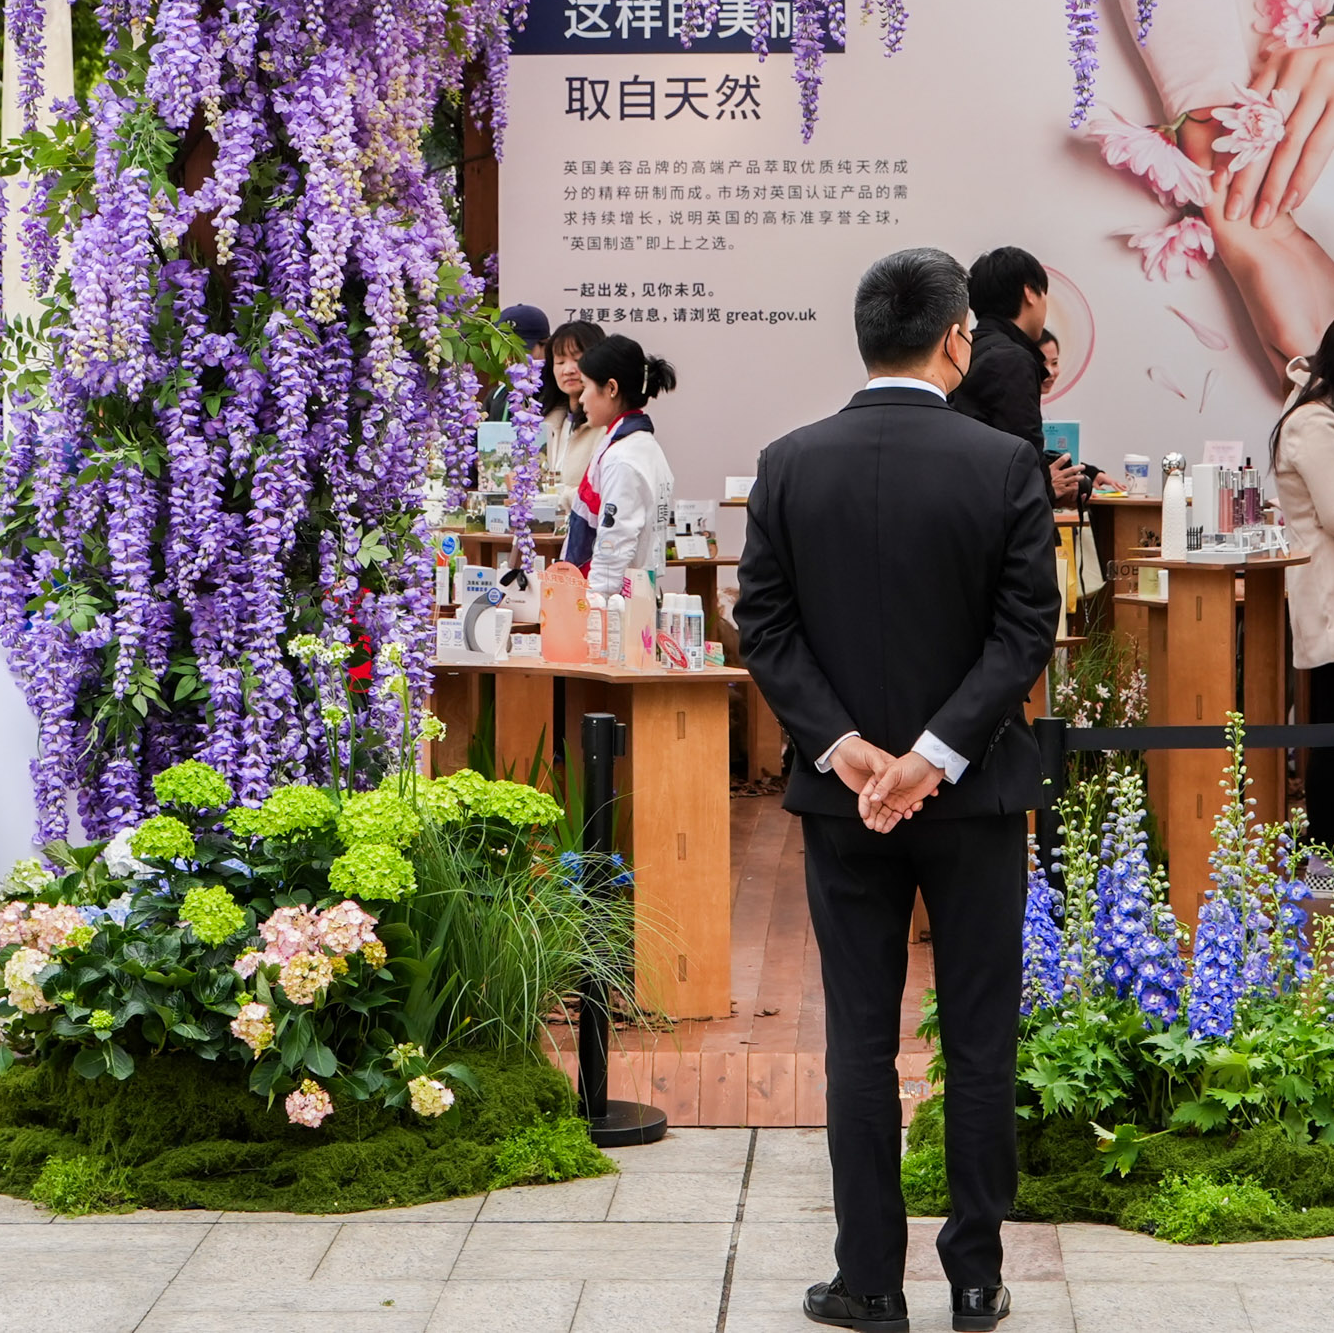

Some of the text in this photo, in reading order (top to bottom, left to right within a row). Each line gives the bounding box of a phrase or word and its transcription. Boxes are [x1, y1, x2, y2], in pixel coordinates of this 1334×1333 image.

[564, 74, 762, 122] 取自天然
[562, 159, 909, 176] 英国美容品牌的高端产品萃取优质纯天然成
[562, 184, 909, 201] 分的精粹研制而成。市场对英国认证产品的需
[726, 308, 817, 324] great.gov.uk
